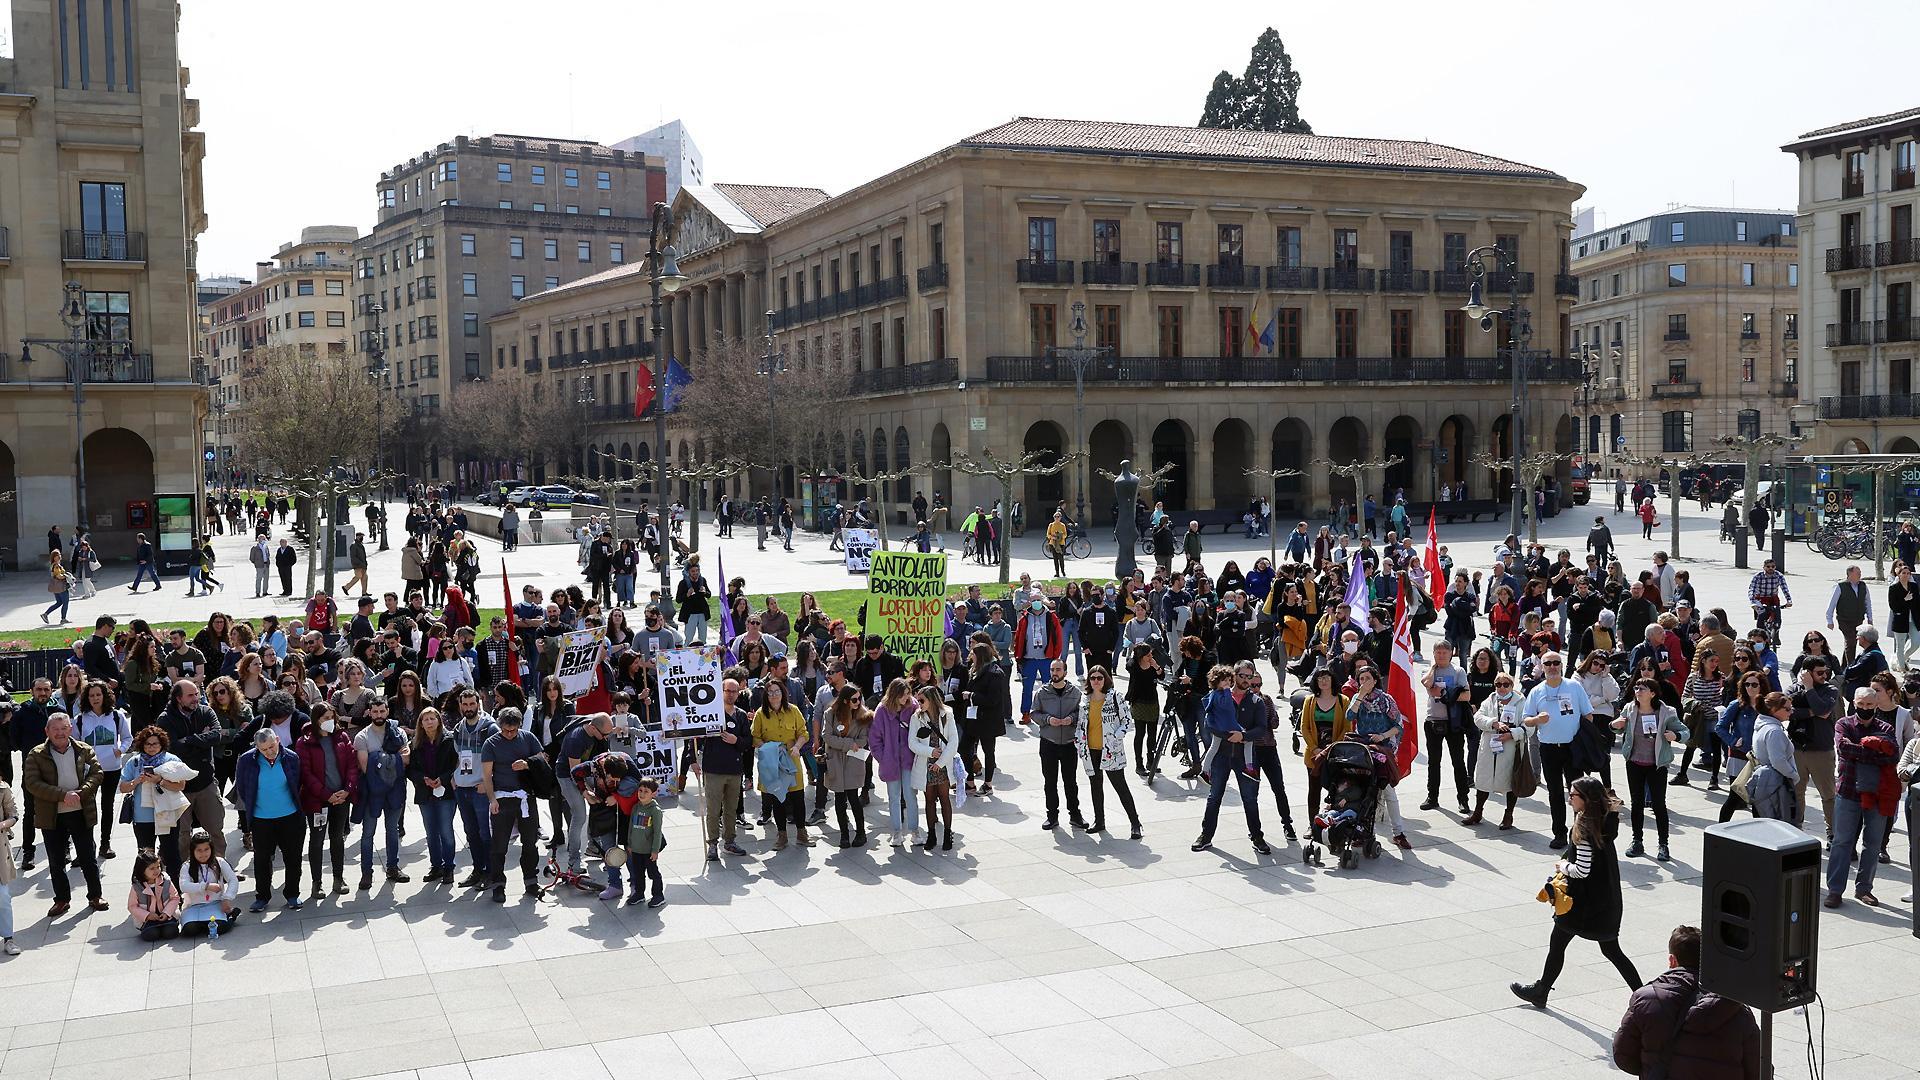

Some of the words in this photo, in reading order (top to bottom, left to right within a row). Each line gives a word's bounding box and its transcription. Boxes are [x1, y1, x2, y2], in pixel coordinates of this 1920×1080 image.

[872, 555, 945, 579] ANTOLATU
[871, 577, 946, 598] BORROKATU
[879, 597, 941, 616] LORTUKO
[883, 635, 941, 654] GANIZATE
[561, 646, 599, 669] BIZI
[663, 674, 714, 686] CONVENIO
[669, 665, 685, 677] ¡EL
[665, 684, 716, 708] NO
[685, 707, 696, 715] SE
[686, 714, 719, 724] TOCA!
